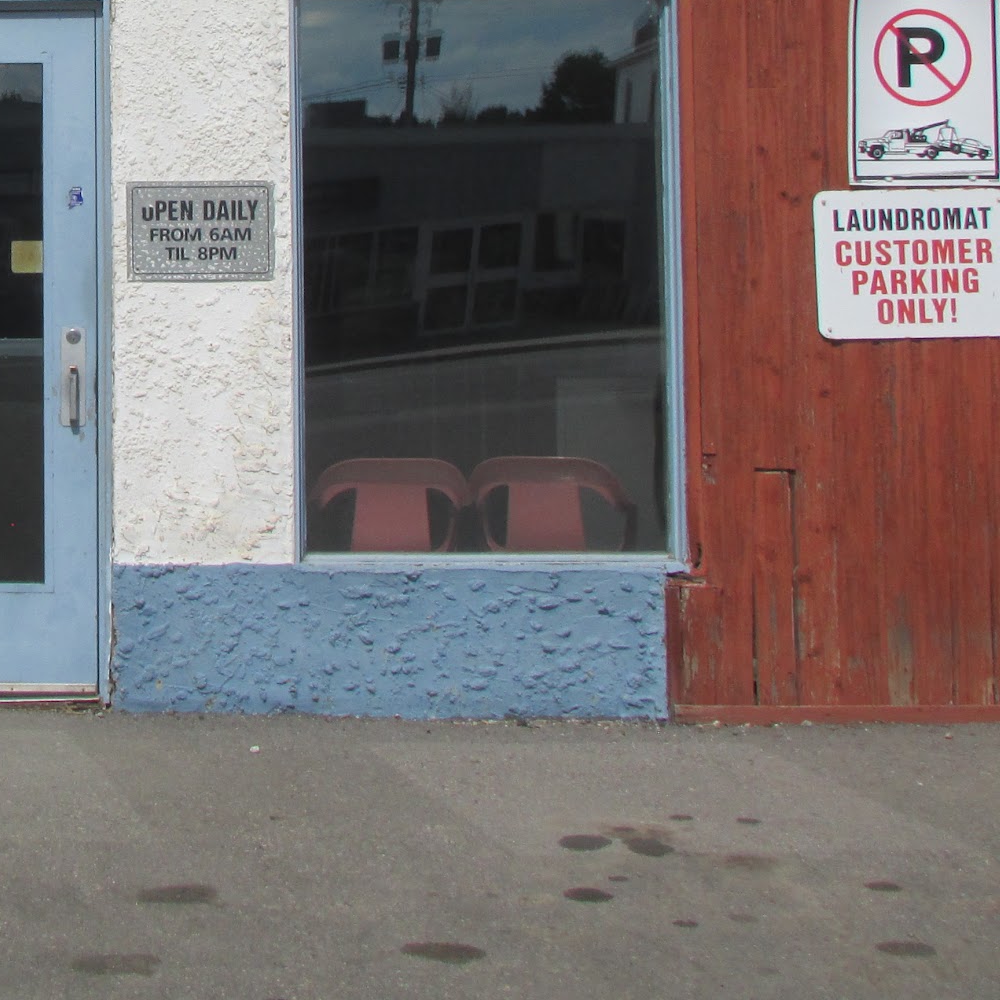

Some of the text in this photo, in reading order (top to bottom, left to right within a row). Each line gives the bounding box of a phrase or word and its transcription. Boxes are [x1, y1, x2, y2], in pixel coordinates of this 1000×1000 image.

[896, 27, 946, 88] P
[202, 199, 259, 221] DAILY
[832, 207, 992, 232] LAUNDROMAT
[149, 227, 252, 242] FROM 6AM
[164, 246, 238, 261] TIL 8PM
[834, 238, 993, 267] CUSTOMER
[851, 267, 980, 296] PARKING
[876, 297, 958, 325] ONLY!
